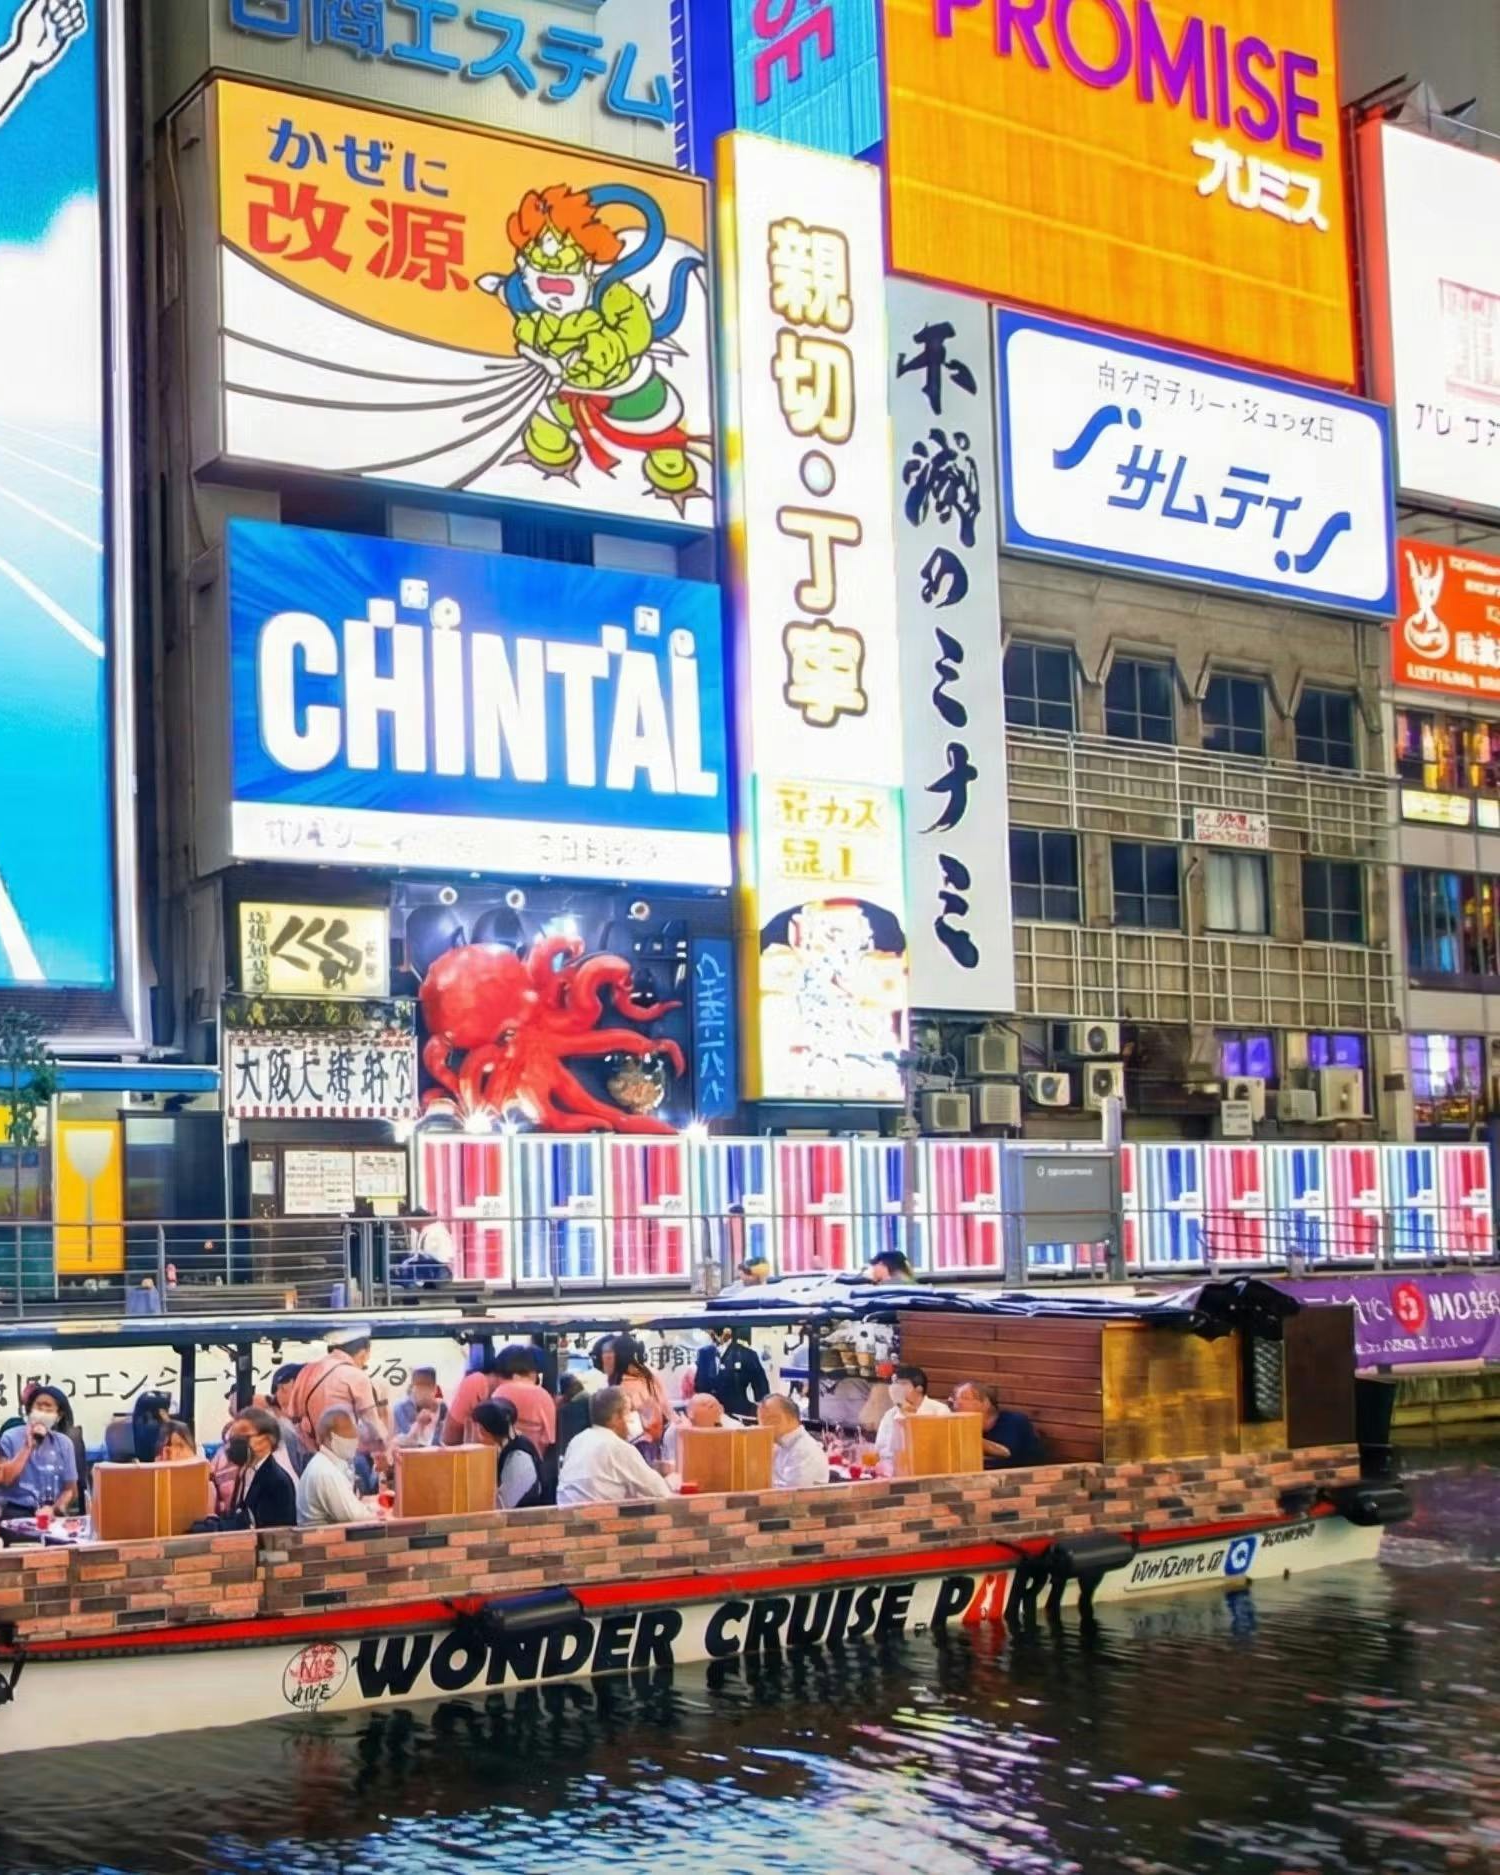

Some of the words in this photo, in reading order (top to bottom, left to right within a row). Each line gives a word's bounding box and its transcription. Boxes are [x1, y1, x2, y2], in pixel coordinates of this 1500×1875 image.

[267, 117, 449, 198] かぜに
[244, 173, 471, 293] 改源
[1107, 445, 1302, 539] サムティ
[356, 1608, 684, 1699] WONDER
[704, 1581, 918, 1658] CRUISE
